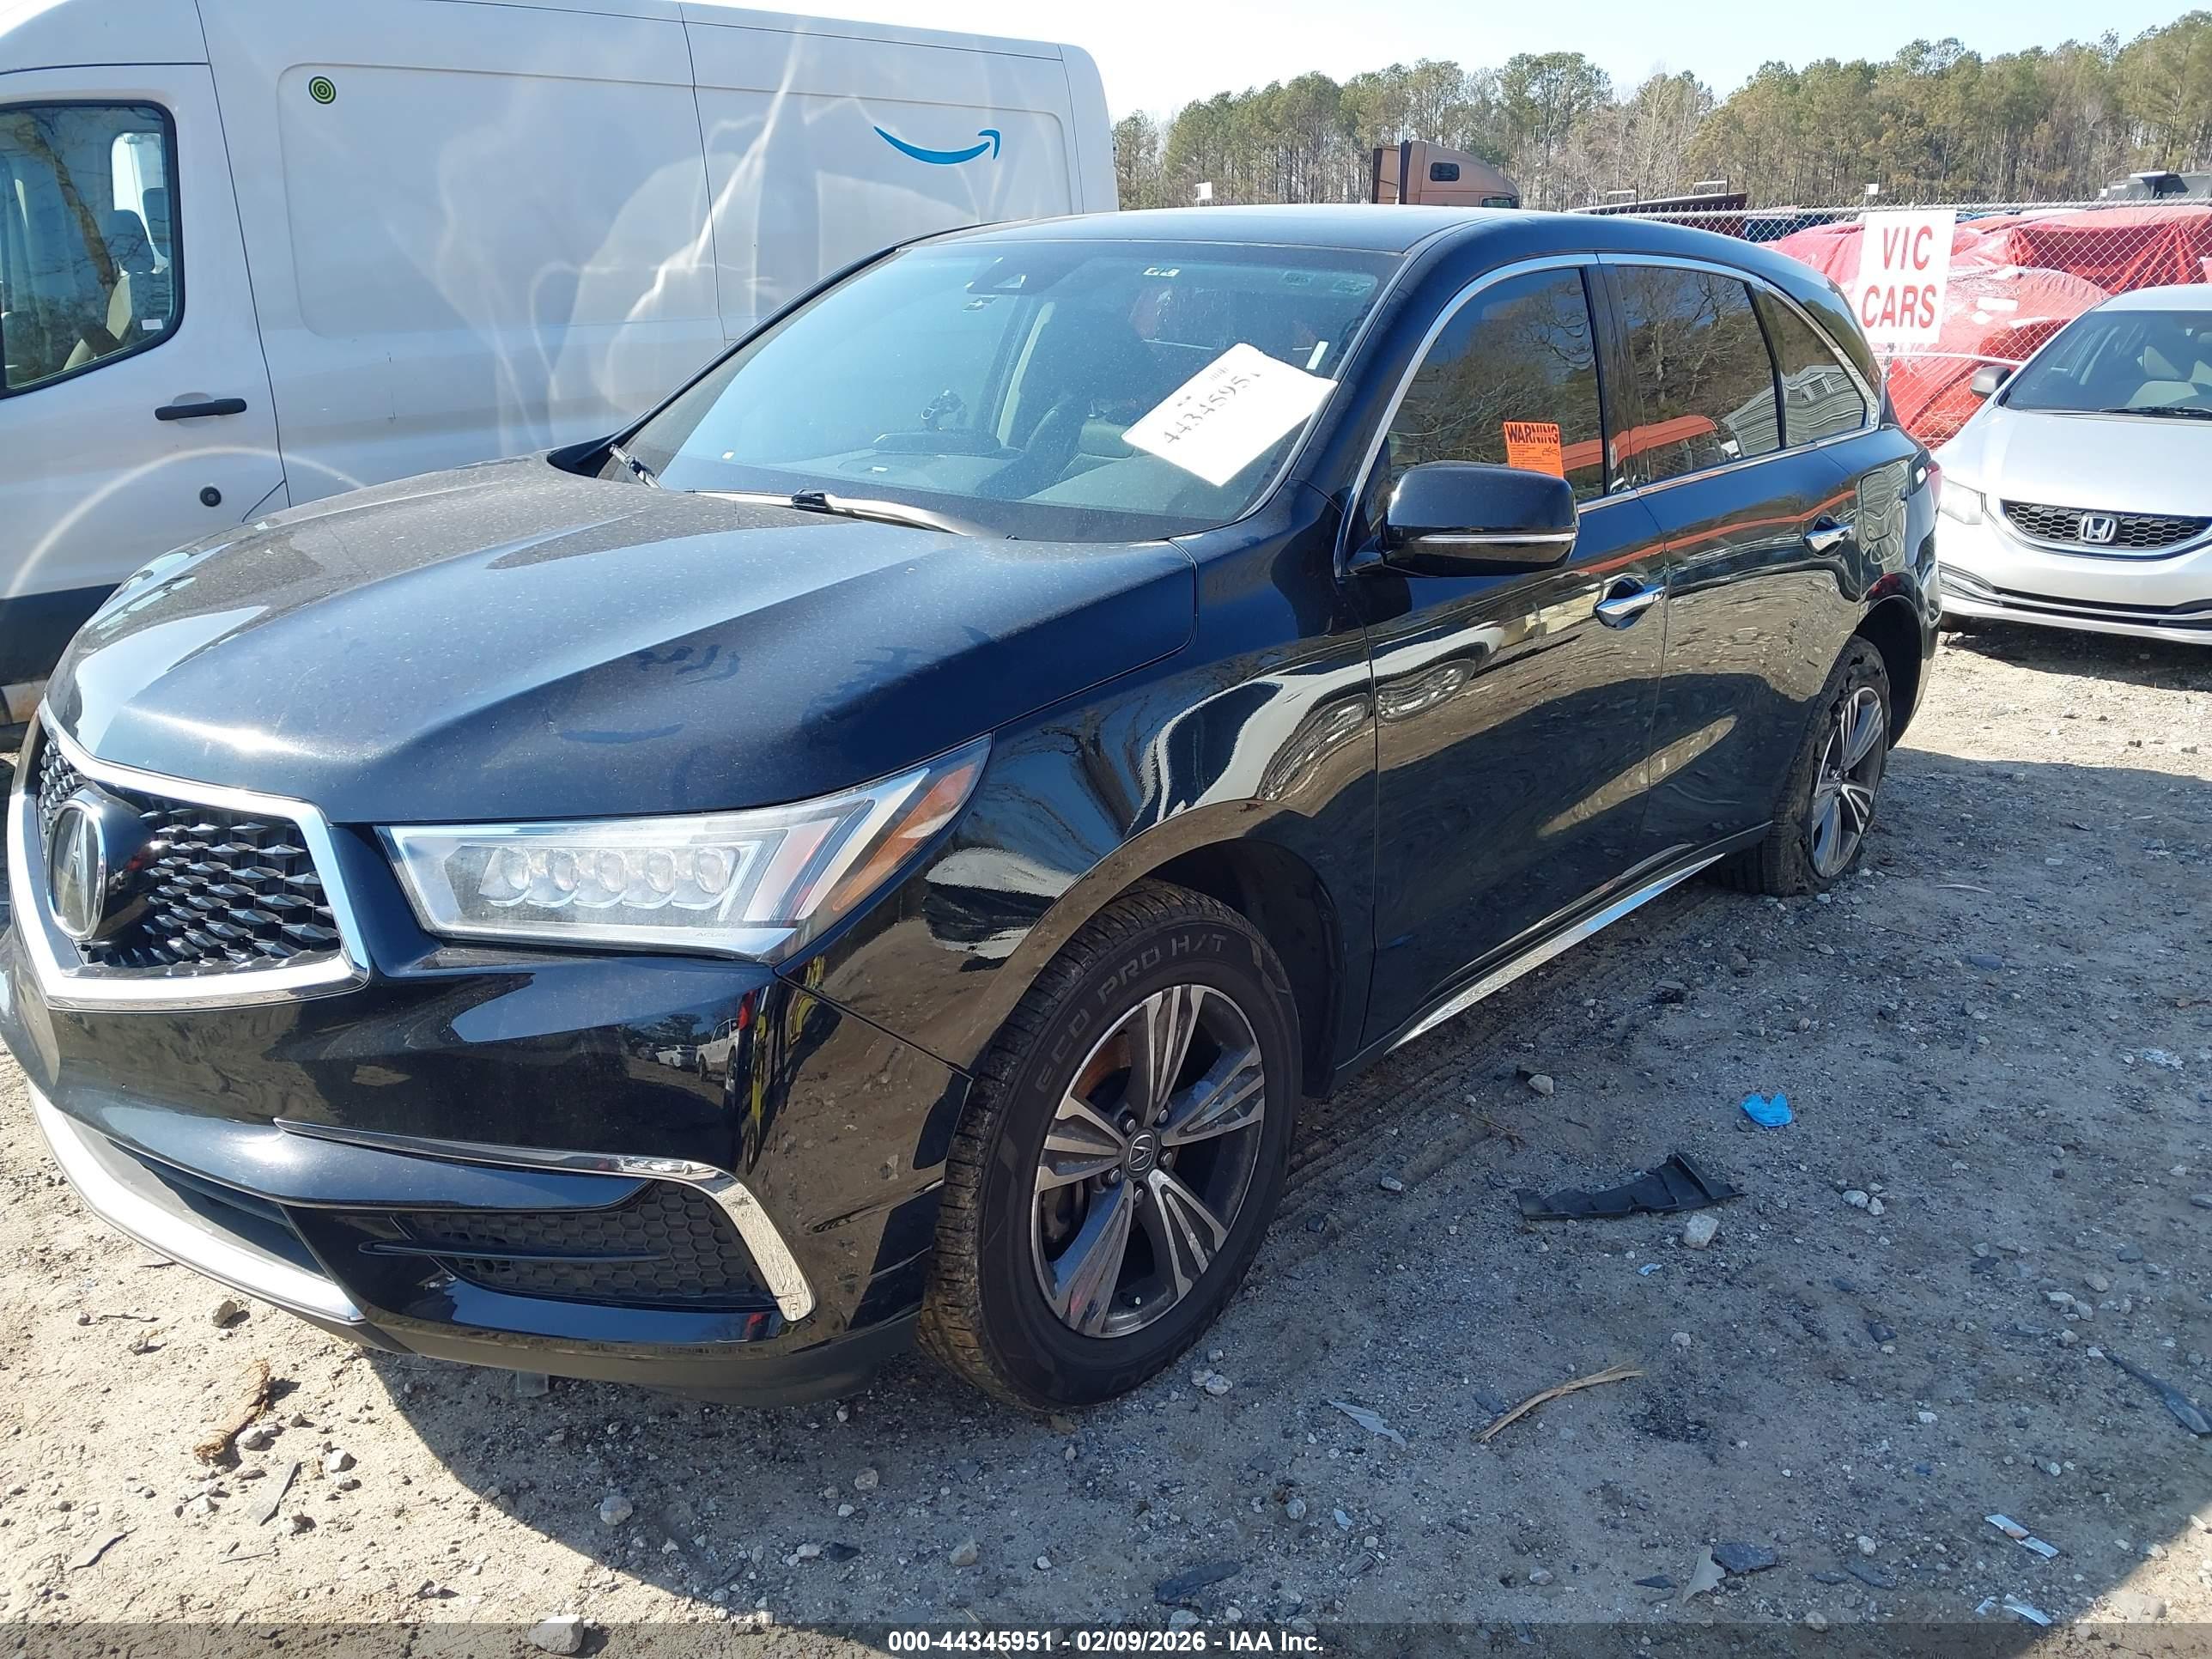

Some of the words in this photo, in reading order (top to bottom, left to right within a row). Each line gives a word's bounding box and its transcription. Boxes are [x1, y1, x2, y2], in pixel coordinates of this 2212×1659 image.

[1883, 225, 1934, 271] VIC
[1861, 283, 1937, 329] CARS
[1505, 423, 1559, 444] WARNING
[1035, 1007, 1092, 1093] ECO
[1096, 946, 1161, 1005] PRO
[1170, 933, 1227, 957] H/T
